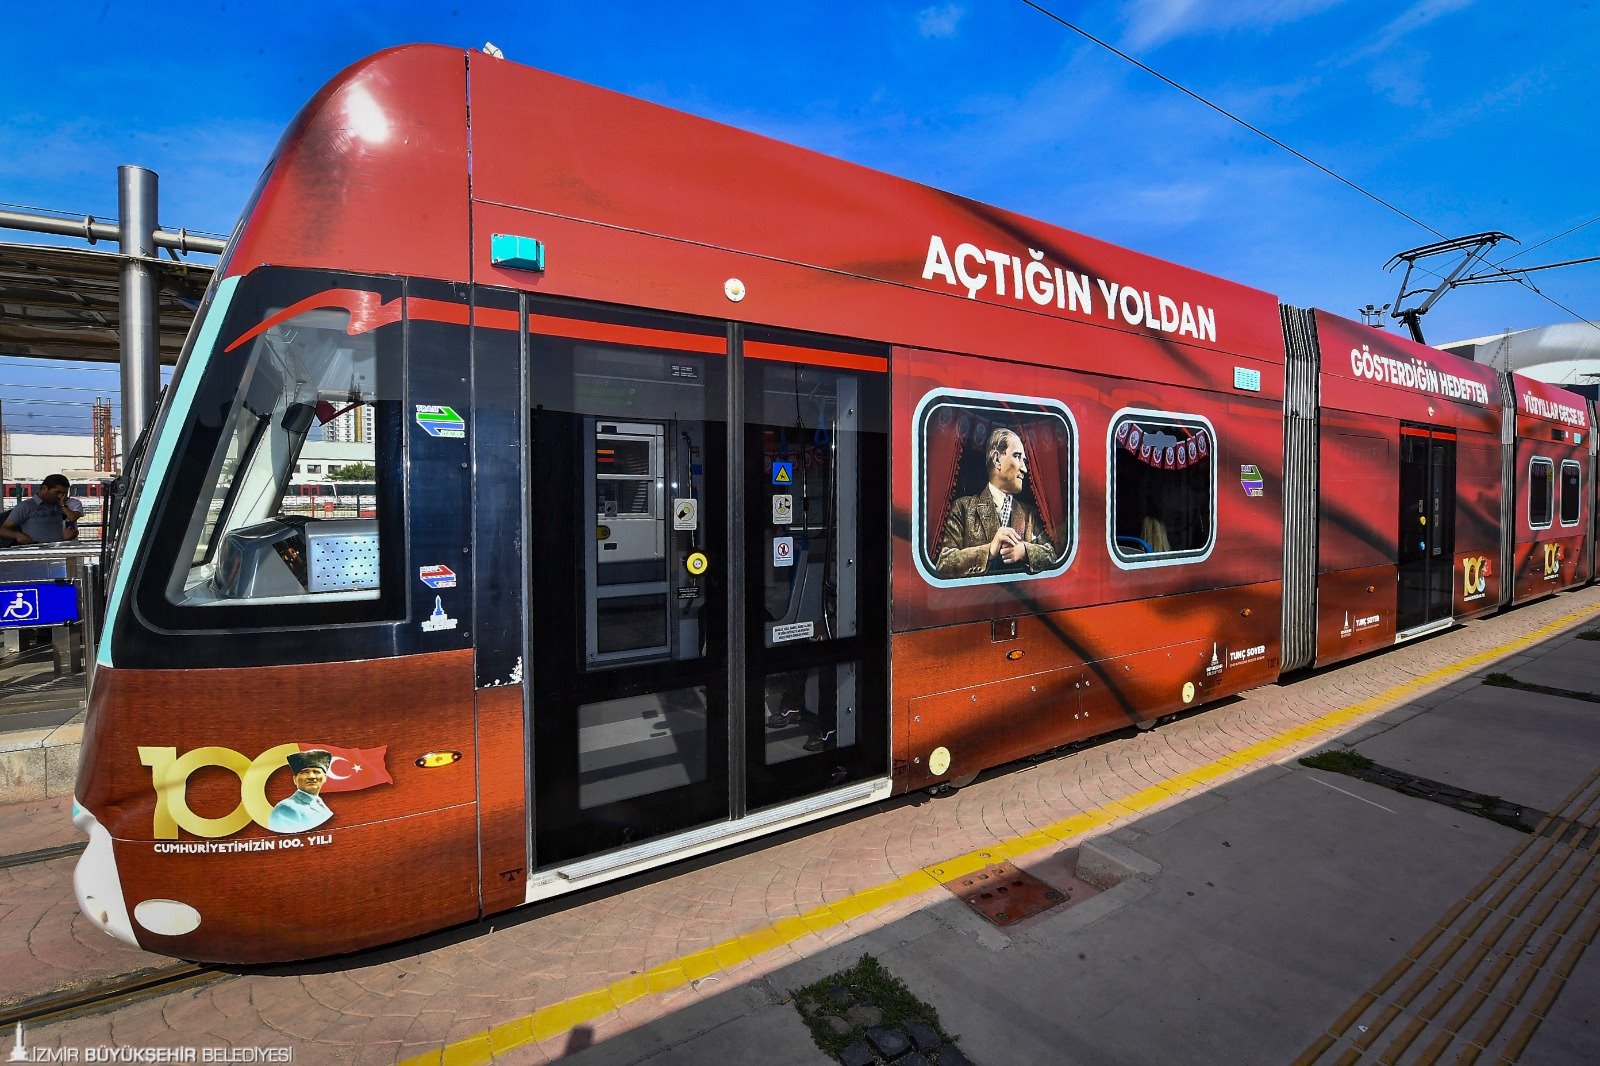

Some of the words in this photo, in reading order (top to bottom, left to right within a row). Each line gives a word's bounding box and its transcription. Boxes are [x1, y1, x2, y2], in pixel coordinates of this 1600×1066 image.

[921, 234, 1092, 315] AÇTIĞIN
[1097, 278, 1217, 343] YOLDAN
[1350, 344, 1439, 394] GÖSTERDİĞİN
[1439, 372, 1489, 404] HEDEFTEN
[153, 840, 275, 854] CUMHURİYETİMİZİN
[278, 837, 304, 850] 100.
